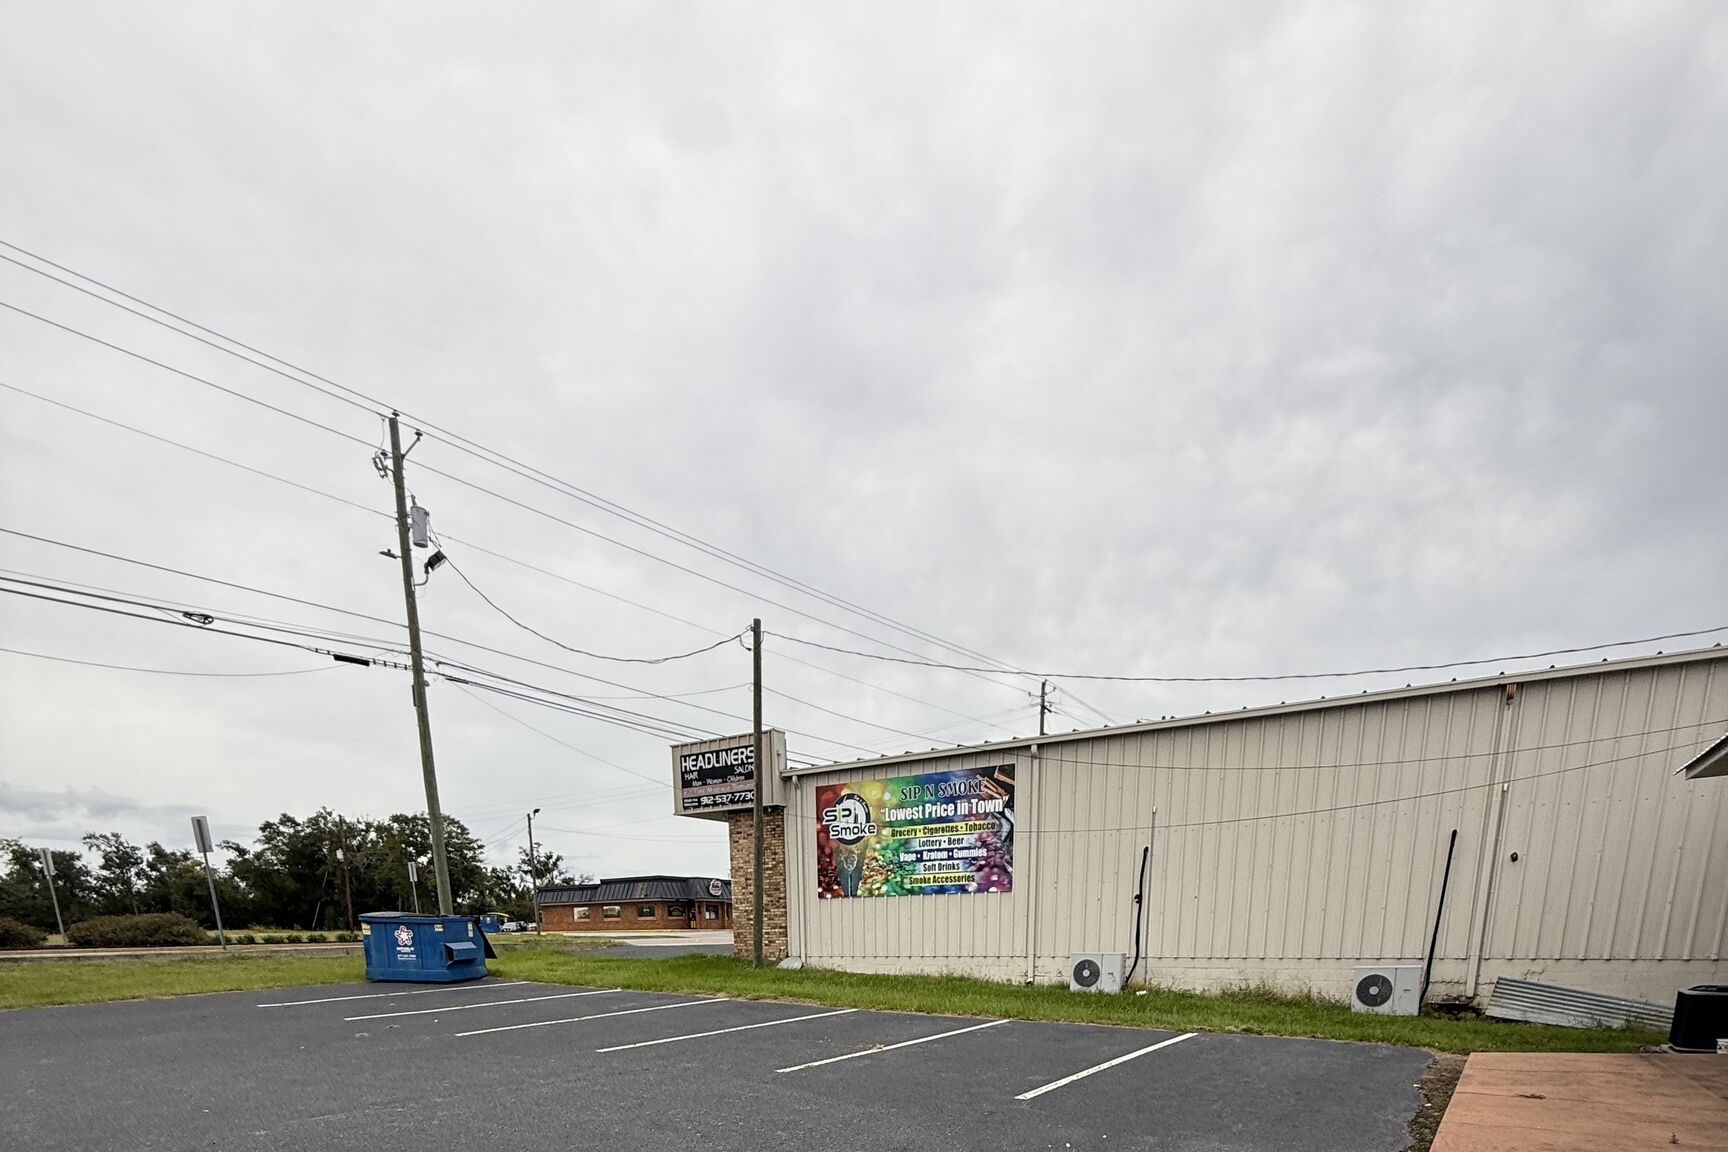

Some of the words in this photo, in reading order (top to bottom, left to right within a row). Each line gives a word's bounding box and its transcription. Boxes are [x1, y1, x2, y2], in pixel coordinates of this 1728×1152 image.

[681, 747, 754, 772] HEADLINERS
[684, 771, 699, 780] HAIR
[734, 764, 754, 774] SALON
[900, 785, 921, 800] SIP
[924, 783, 935, 799] N
[938, 779, 986, 797] SMOKE
[925, 802, 955, 819] Price
[957, 800, 968, 815] in
[829, 822, 877, 838] Smoke
[891, 828, 918, 838] Grocery
[922, 825, 959, 836] Cigarettes
[964, 821, 996, 832] Tobacco
[918, 838, 942, 848] Lottery
[947, 837, 965, 846] Beer
[899, 852, 917, 862] Vape
[922, 851, 948, 860] Kratom
[953, 848, 988, 858] Gummies
[922, 863, 937, 872] Soft
[938, 862, 960, 871] Drinks
[908, 876, 932, 885] Smoke
[932, 873, 976, 884] Accessories
